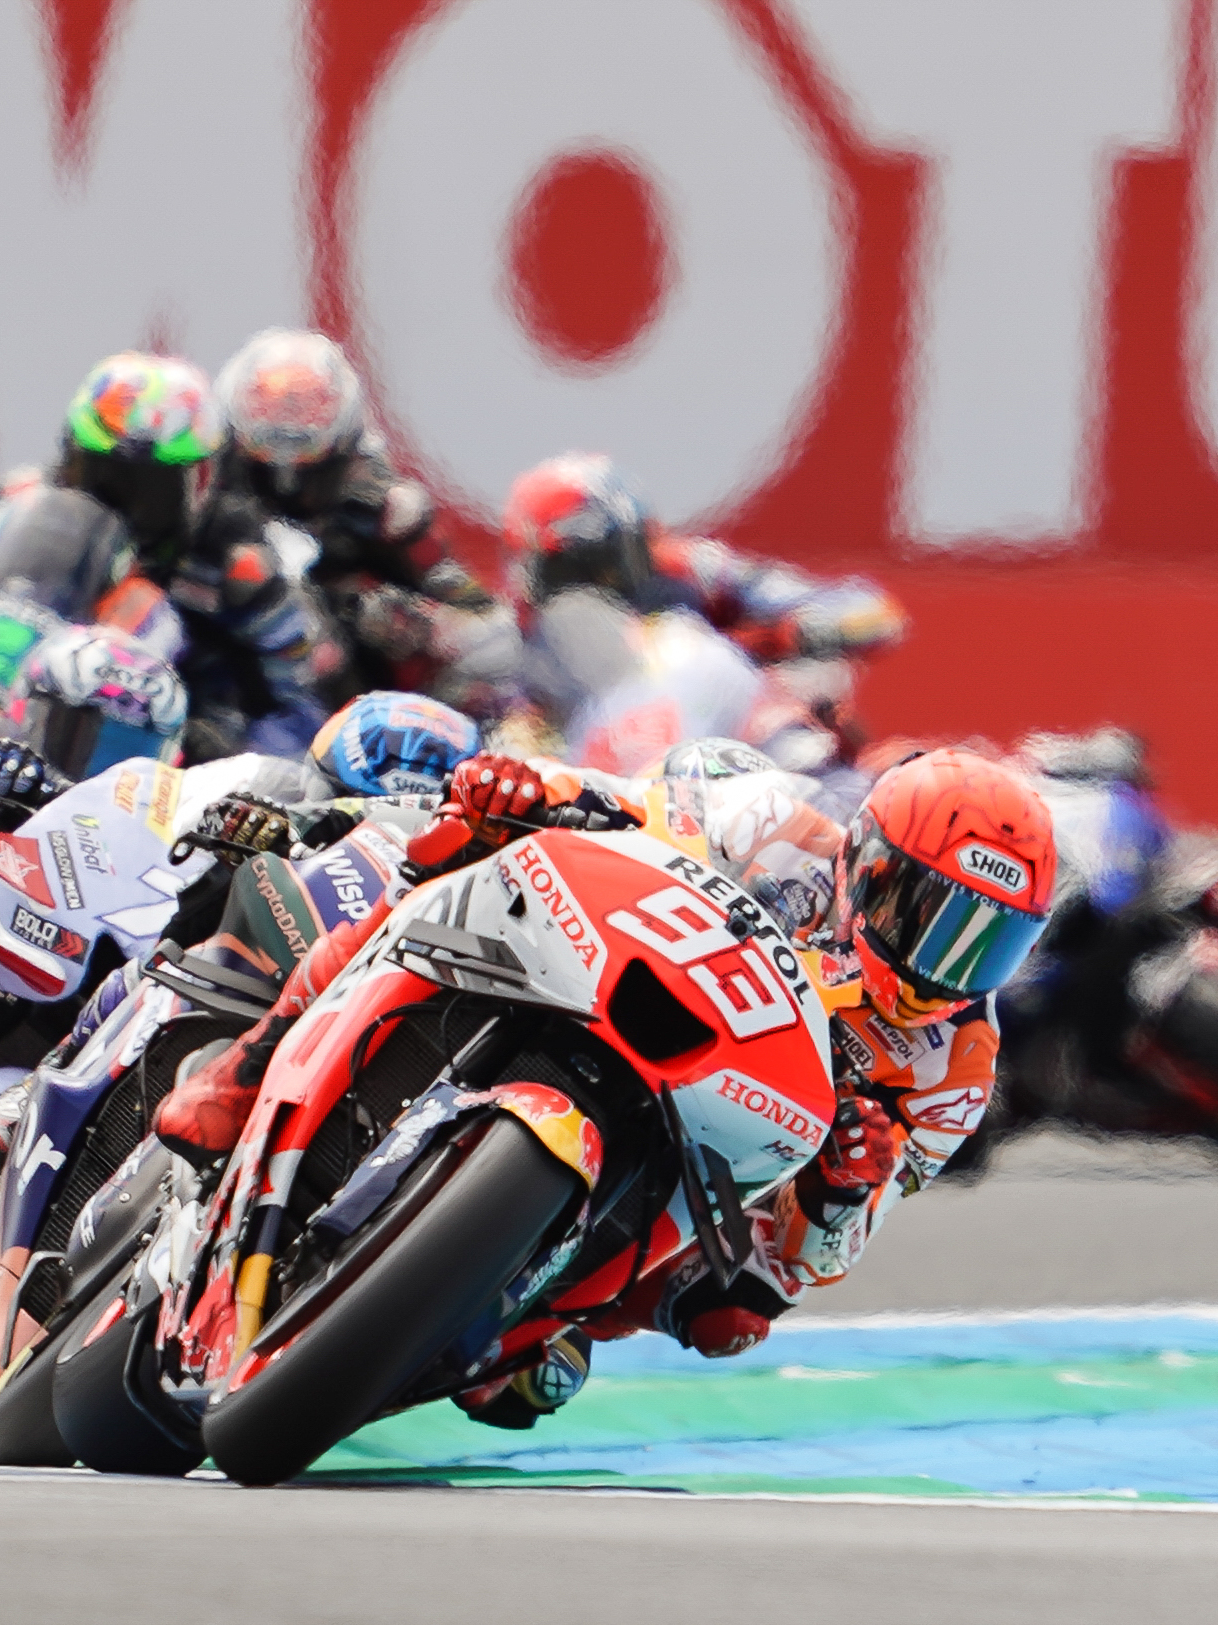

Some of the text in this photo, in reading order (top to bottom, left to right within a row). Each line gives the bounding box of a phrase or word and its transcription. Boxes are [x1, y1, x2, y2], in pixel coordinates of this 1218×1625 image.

[72, 813, 109, 875] Unibat
[968, 850, 1021, 889] SHOEI
[14, 908, 58, 941] BOLD
[514, 843, 599, 972] HONDA
[664, 855, 811, 1006] REPSOL
[605, 886, 798, 1038] 93
[840, 1031, 873, 1068] HOEI
[715, 1074, 824, 1149] HONDA
